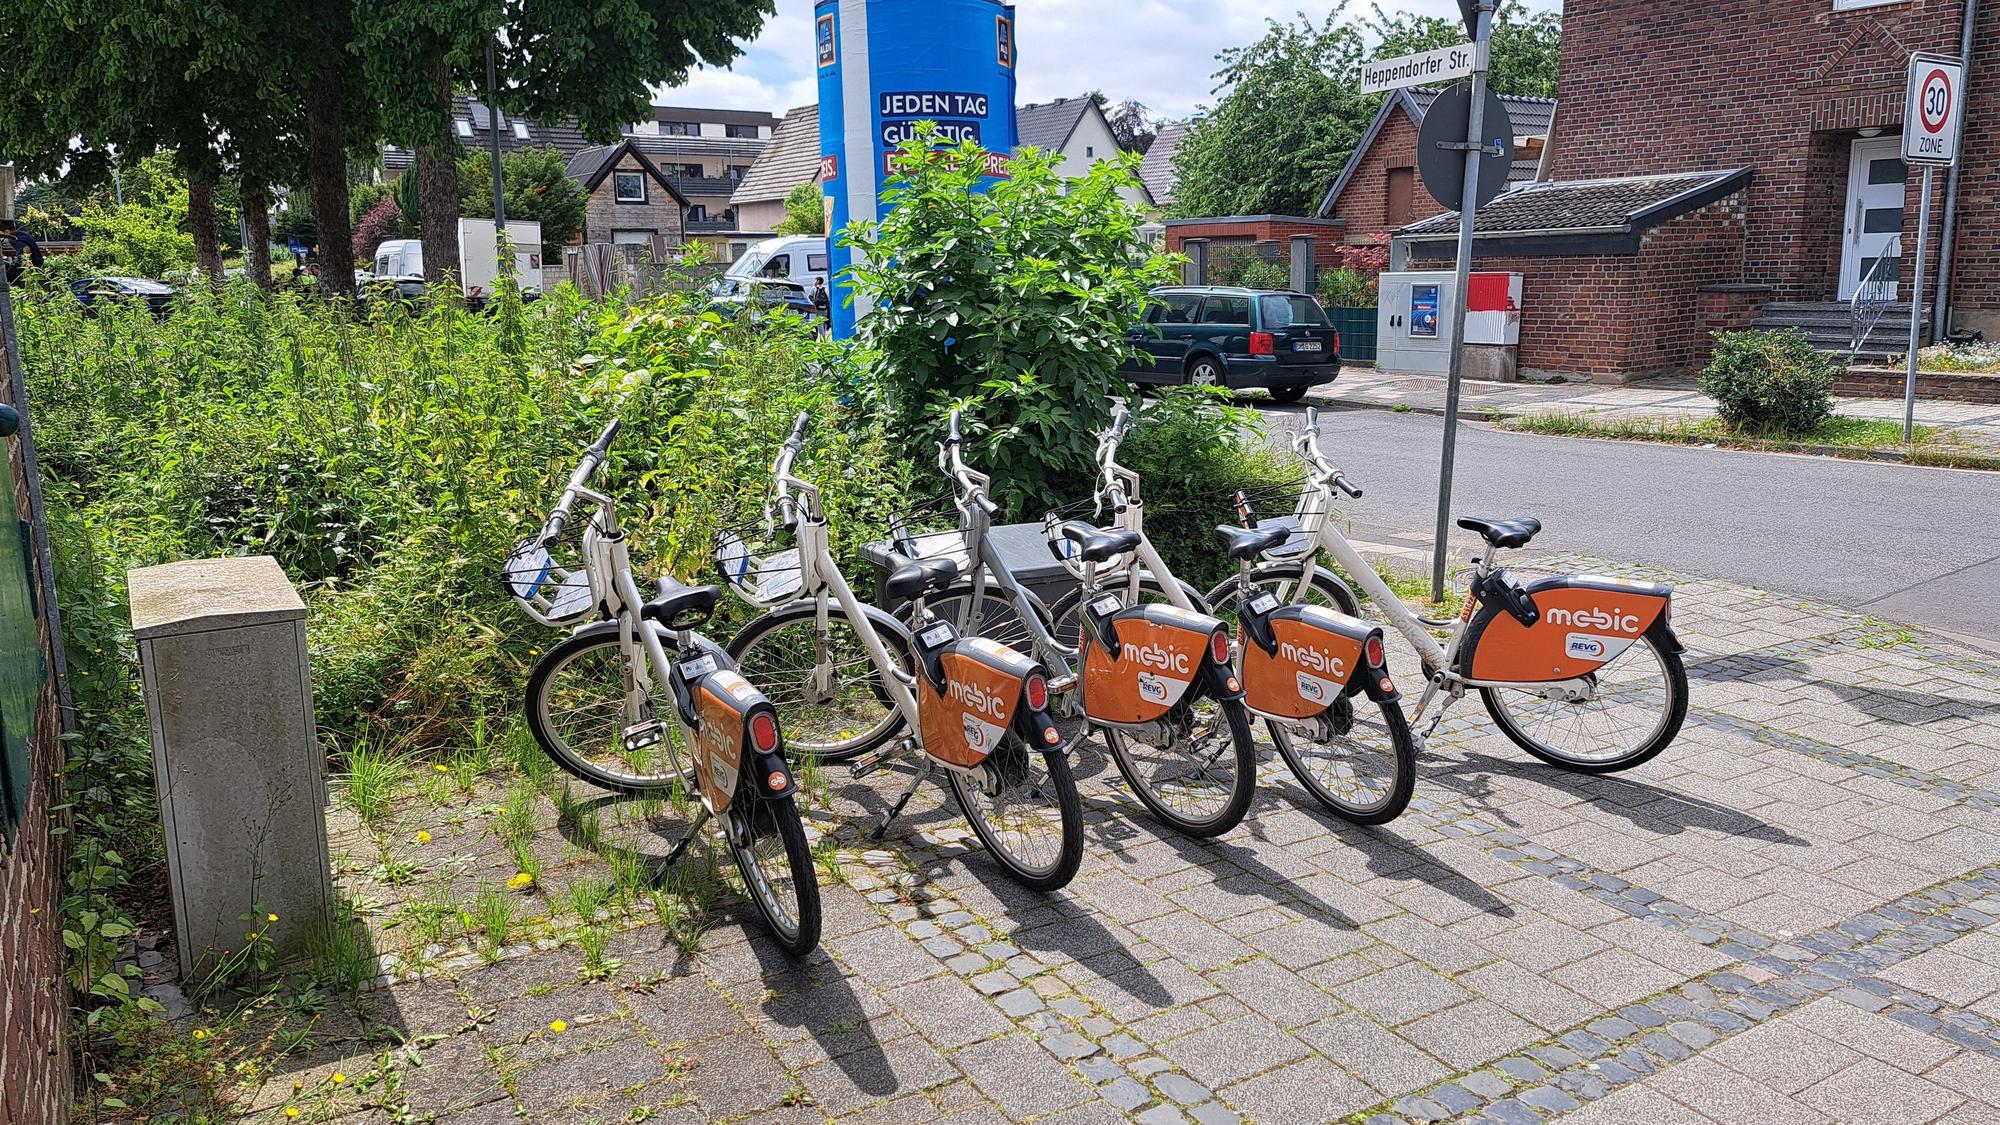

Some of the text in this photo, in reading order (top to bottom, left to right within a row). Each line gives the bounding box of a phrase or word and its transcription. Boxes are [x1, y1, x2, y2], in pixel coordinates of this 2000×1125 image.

[820, 43, 832, 55] ALDI
[1364, 51, 1470, 88] Heppendorfer Str.
[882, 95, 988, 115] JEDEN TAG
[1926, 86, 1945, 116] 30
[884, 121, 980, 145] GÜSTIG.
[1919, 137, 1944, 154] ZONE
[982, 155, 1010, 176] PREI
[1546, 606, 1639, 633] mobic
[1570, 642, 1598, 652] REVG
[1124, 642, 1190, 675] mobic
[1281, 642, 1345, 678] mobic
[1143, 683, 1162, 694] REVG
[1301, 681, 1319, 694] REVG
[950, 679, 1006, 720] mobic
